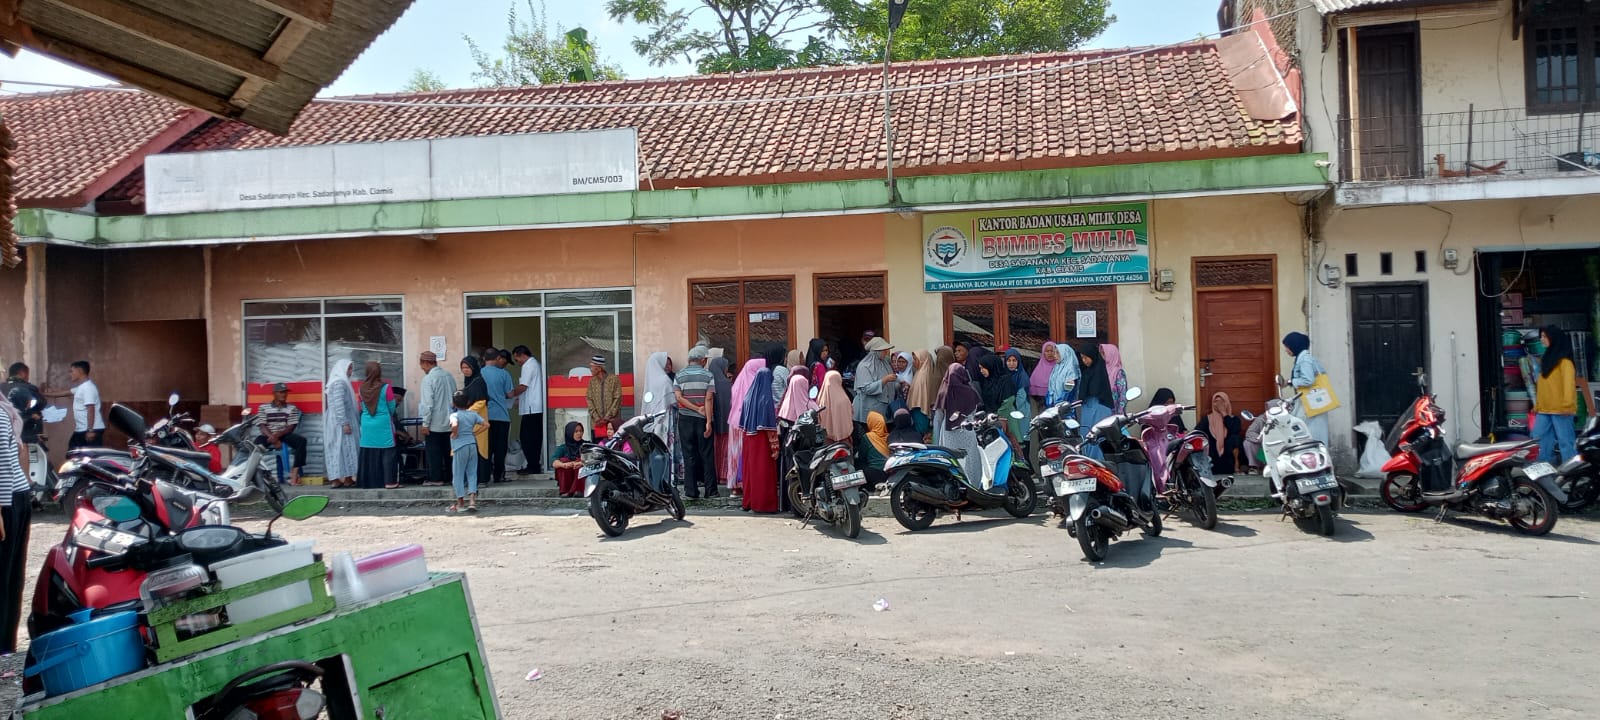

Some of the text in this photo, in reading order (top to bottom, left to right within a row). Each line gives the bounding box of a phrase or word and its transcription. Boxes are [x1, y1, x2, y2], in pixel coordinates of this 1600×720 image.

[239, 193, 257, 201] Desa
[369, 187, 393, 195] Ciamis
[979, 210, 1142, 231] KANTOR BADAN USAHA MILIK DESA
[982, 232, 1067, 258] BUMDES
[1072, 229, 1137, 253] MULIA
[989, 260, 1009, 268] DESA
[1011, 257, 1060, 267] SADANANYA
[1080, 254, 1131, 264] SADANANYA
[1055, 264, 1084, 273] CIAMIS
[1058, 276, 1094, 284] SADANANYA
